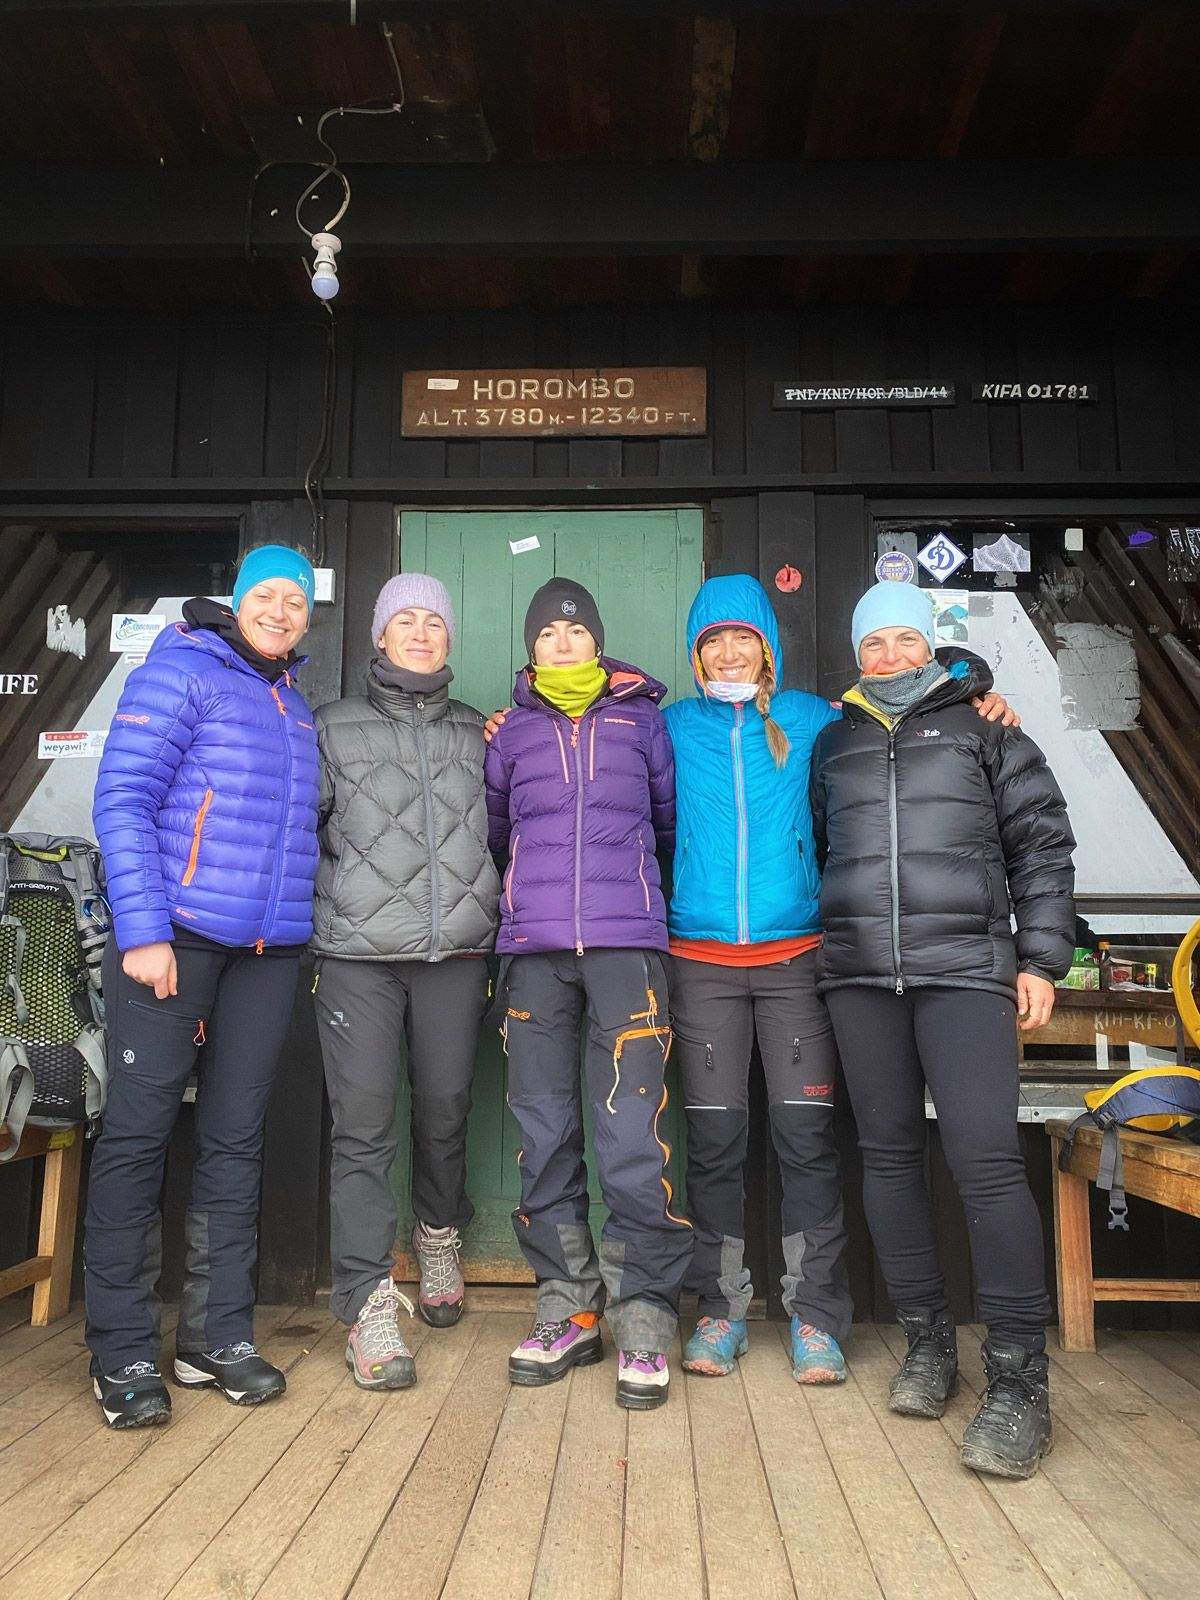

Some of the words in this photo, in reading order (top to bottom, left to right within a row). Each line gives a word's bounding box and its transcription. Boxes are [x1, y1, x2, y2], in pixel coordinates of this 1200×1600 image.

[473, 378, 635, 400] HOROMBO
[982, 384, 1022, 399] KIFA
[417, 409, 468, 426] ALT.
[476, 407, 543, 425] 3780
[924, 729, 941, 738] Rab
